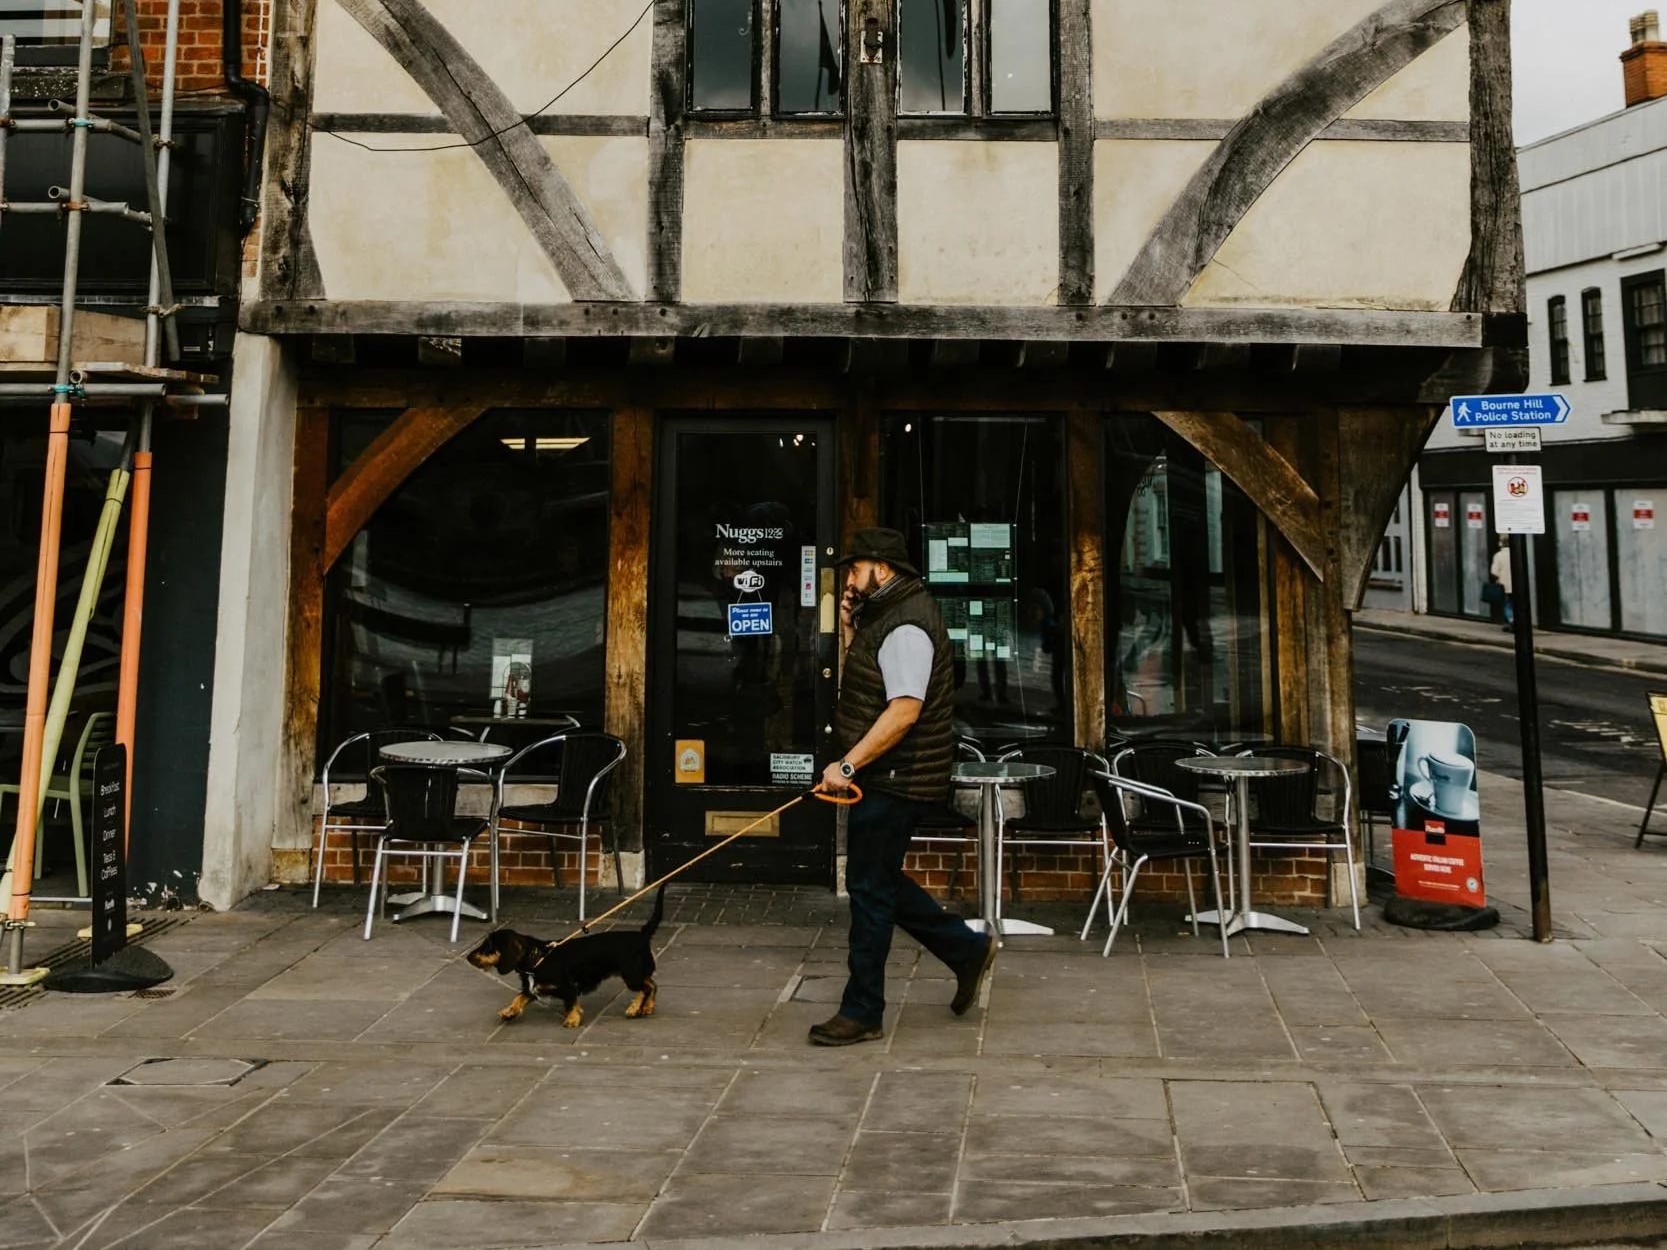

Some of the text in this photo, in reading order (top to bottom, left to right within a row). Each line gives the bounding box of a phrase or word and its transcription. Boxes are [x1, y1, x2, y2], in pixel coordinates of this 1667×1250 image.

[1481, 399, 1543, 410] Bourne Hill
[1475, 410, 1552, 422] Police Station
[1489, 431, 1536, 440] No loading
[1518, 440, 1538, 448] time
[715, 523, 764, 544] Nuggs
[723, 548, 775, 558] More seating
[714, 557, 783, 568] available upstairs
[731, 618, 770, 632] OPEN
[102, 829, 117, 841] Dinner
